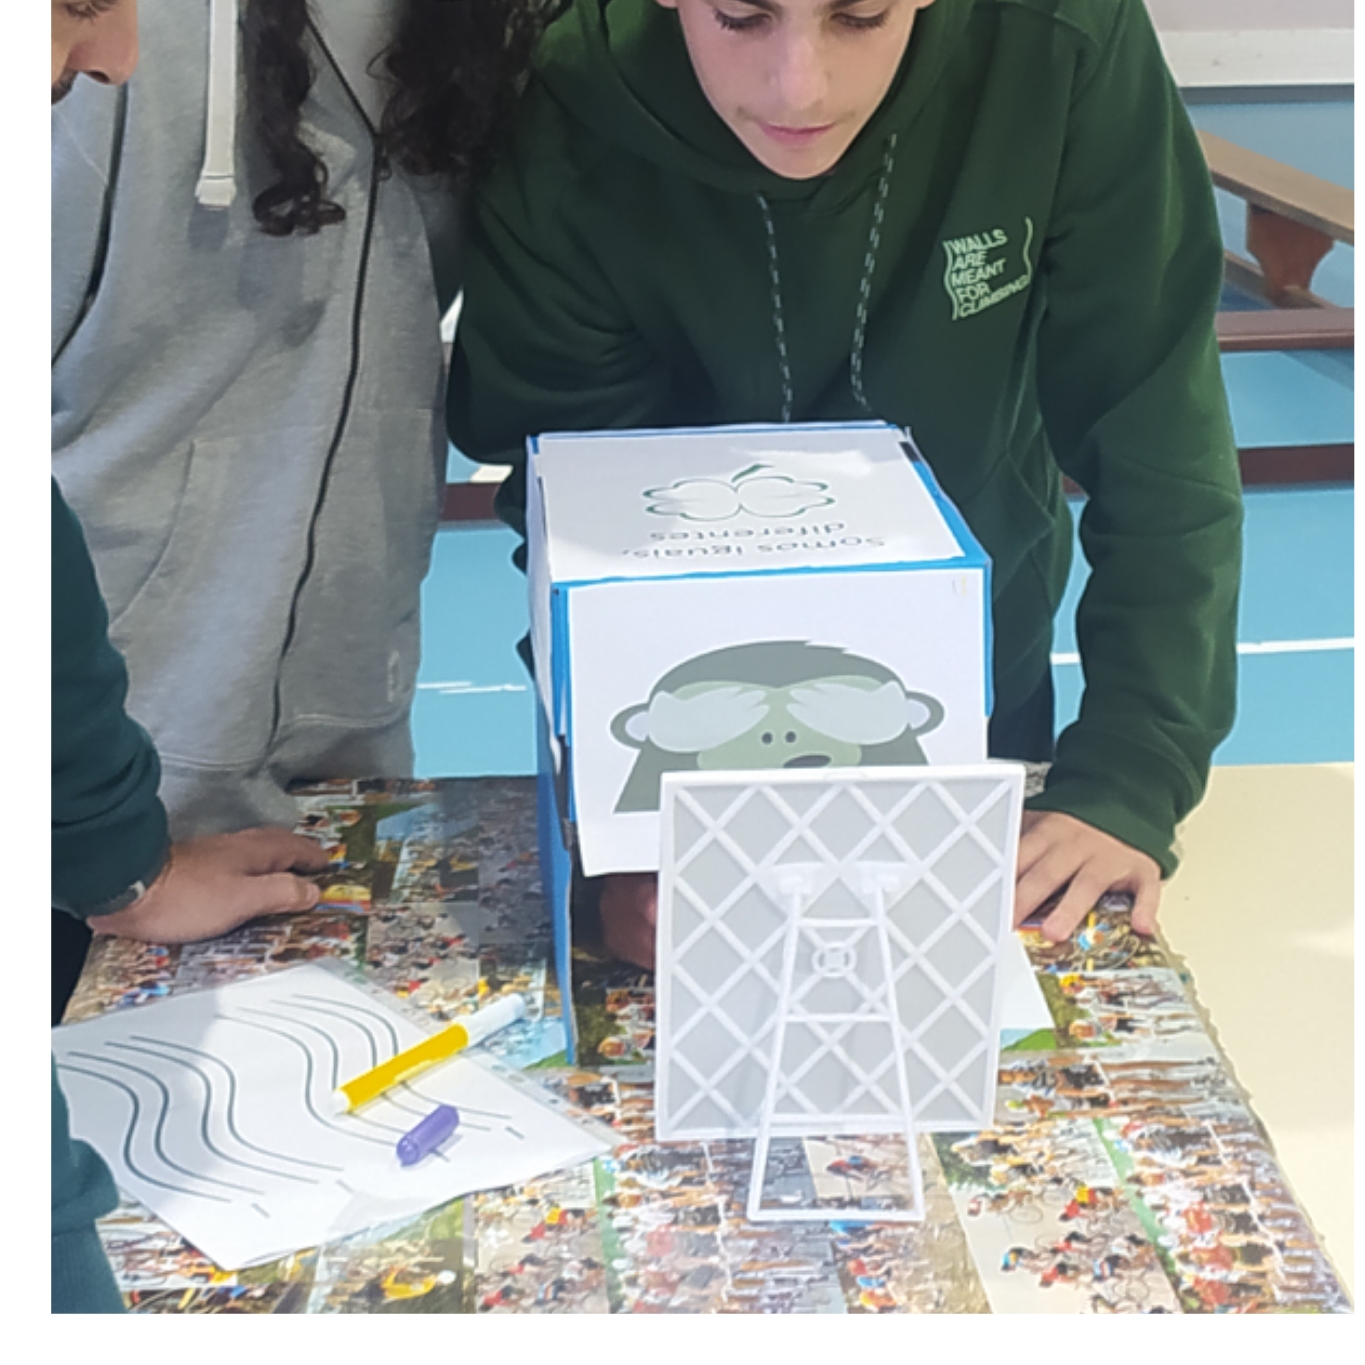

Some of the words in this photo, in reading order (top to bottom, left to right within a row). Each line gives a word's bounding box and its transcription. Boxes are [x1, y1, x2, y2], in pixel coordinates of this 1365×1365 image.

[950, 228, 1009, 255] WALLS
[951, 250, 988, 271] ARE
[951, 257, 1007, 287] MEANT
[955, 281, 991, 304] FOR
